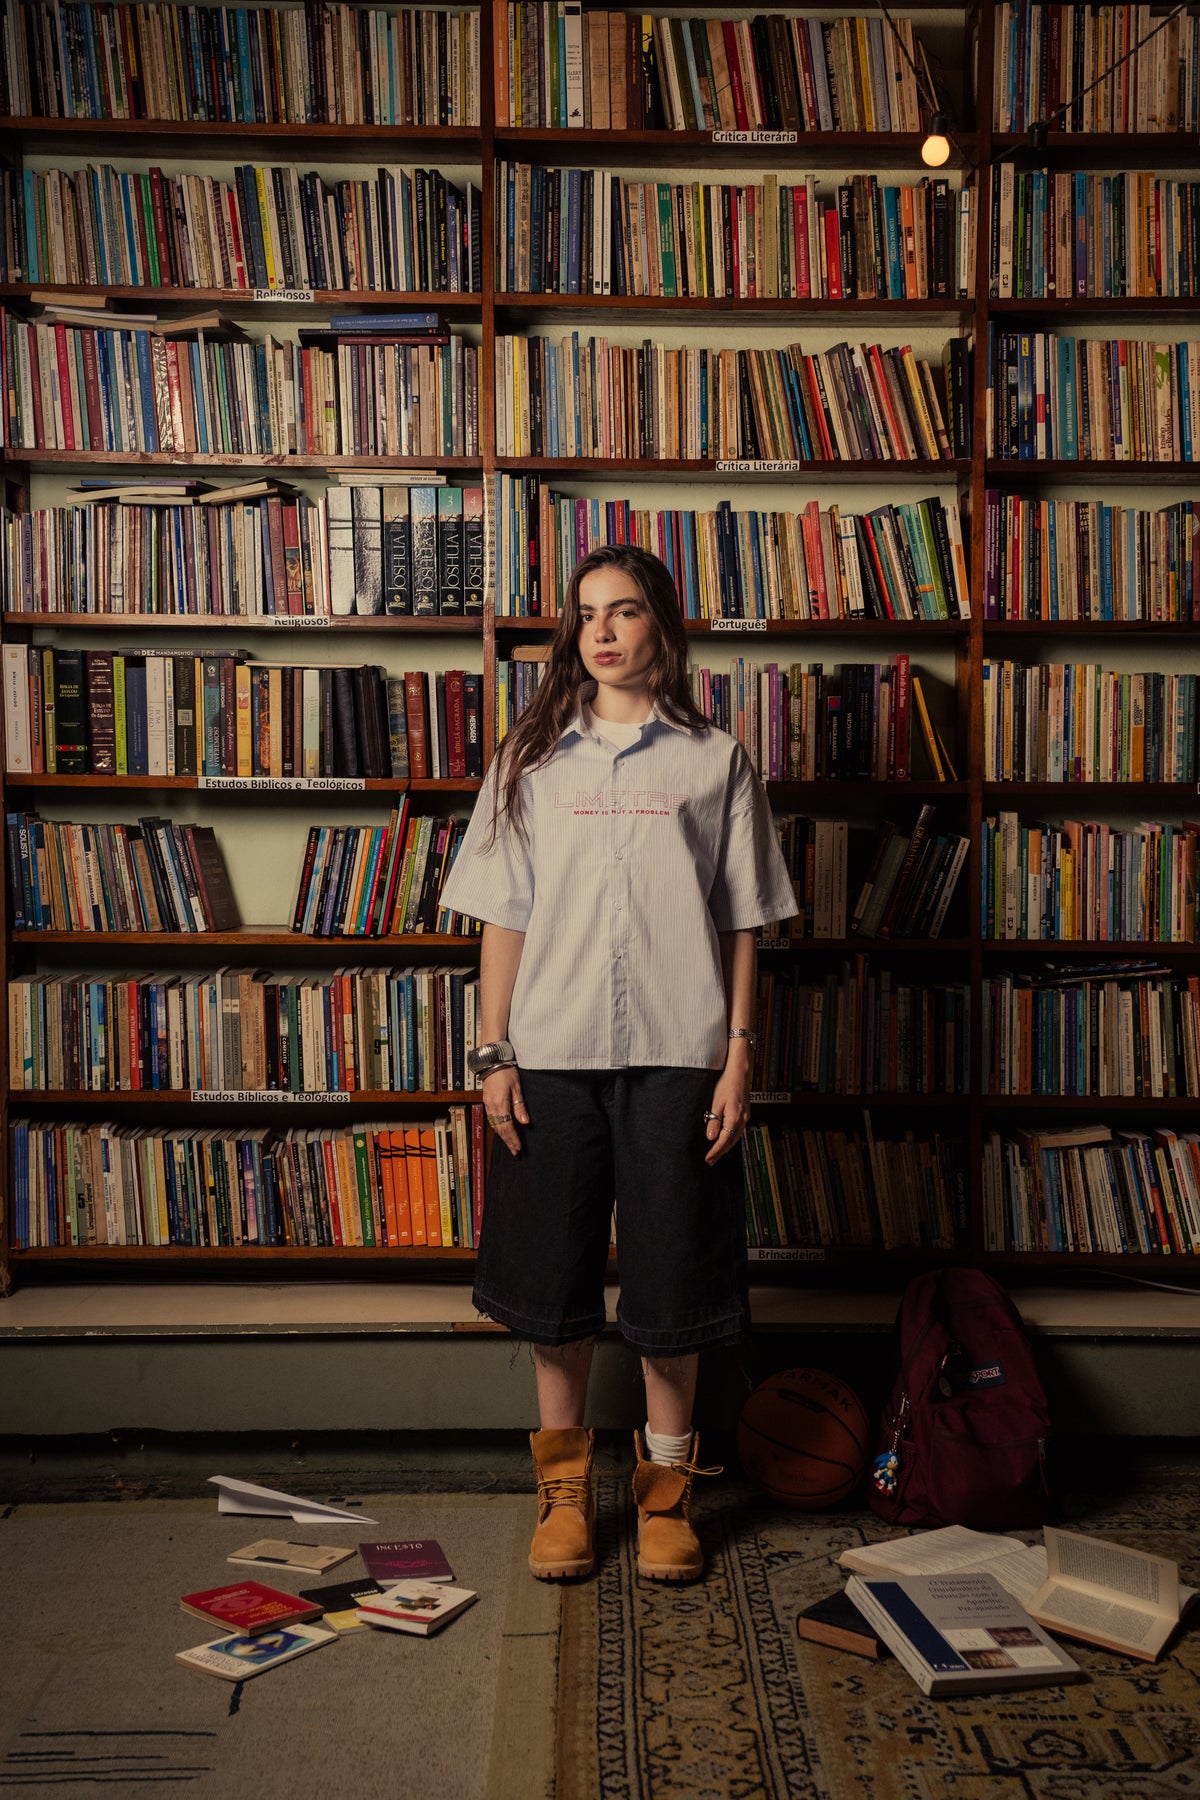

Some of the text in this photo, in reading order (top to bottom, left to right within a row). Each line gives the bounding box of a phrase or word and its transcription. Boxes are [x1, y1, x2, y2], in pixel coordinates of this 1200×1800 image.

[714, 131, 796, 144] Crítica Literária
[841, 190, 849, 204] Bella
[256, 290, 310, 302] Religiosos
[716, 460, 798, 472] Crítica Literária
[387, 534, 408, 592] JOSHUA
[441, 534, 460, 591] JOSHUA
[466, 535, 484, 590] JOSHUA
[274, 616, 330, 630] Religiosos
[712, 619, 766, 632] Português
[205, 779, 248, 790] Estudos
[251, 778, 292, 790] Bíblicos
[306, 780, 364, 792] Teológicos
[19, 829, 28, 859] SOLISTA
[902, 826, 926, 875] GRAMÁTICA
[756, 937, 788, 950] dação
[193, 1092, 350, 1106] Estudos Bíblicos e Teológicos
[749, 1091, 788, 1102] entífica
[759, 1251, 826, 1262] Brincadeiras
[376, 1543, 423, 1552] INCESTO
